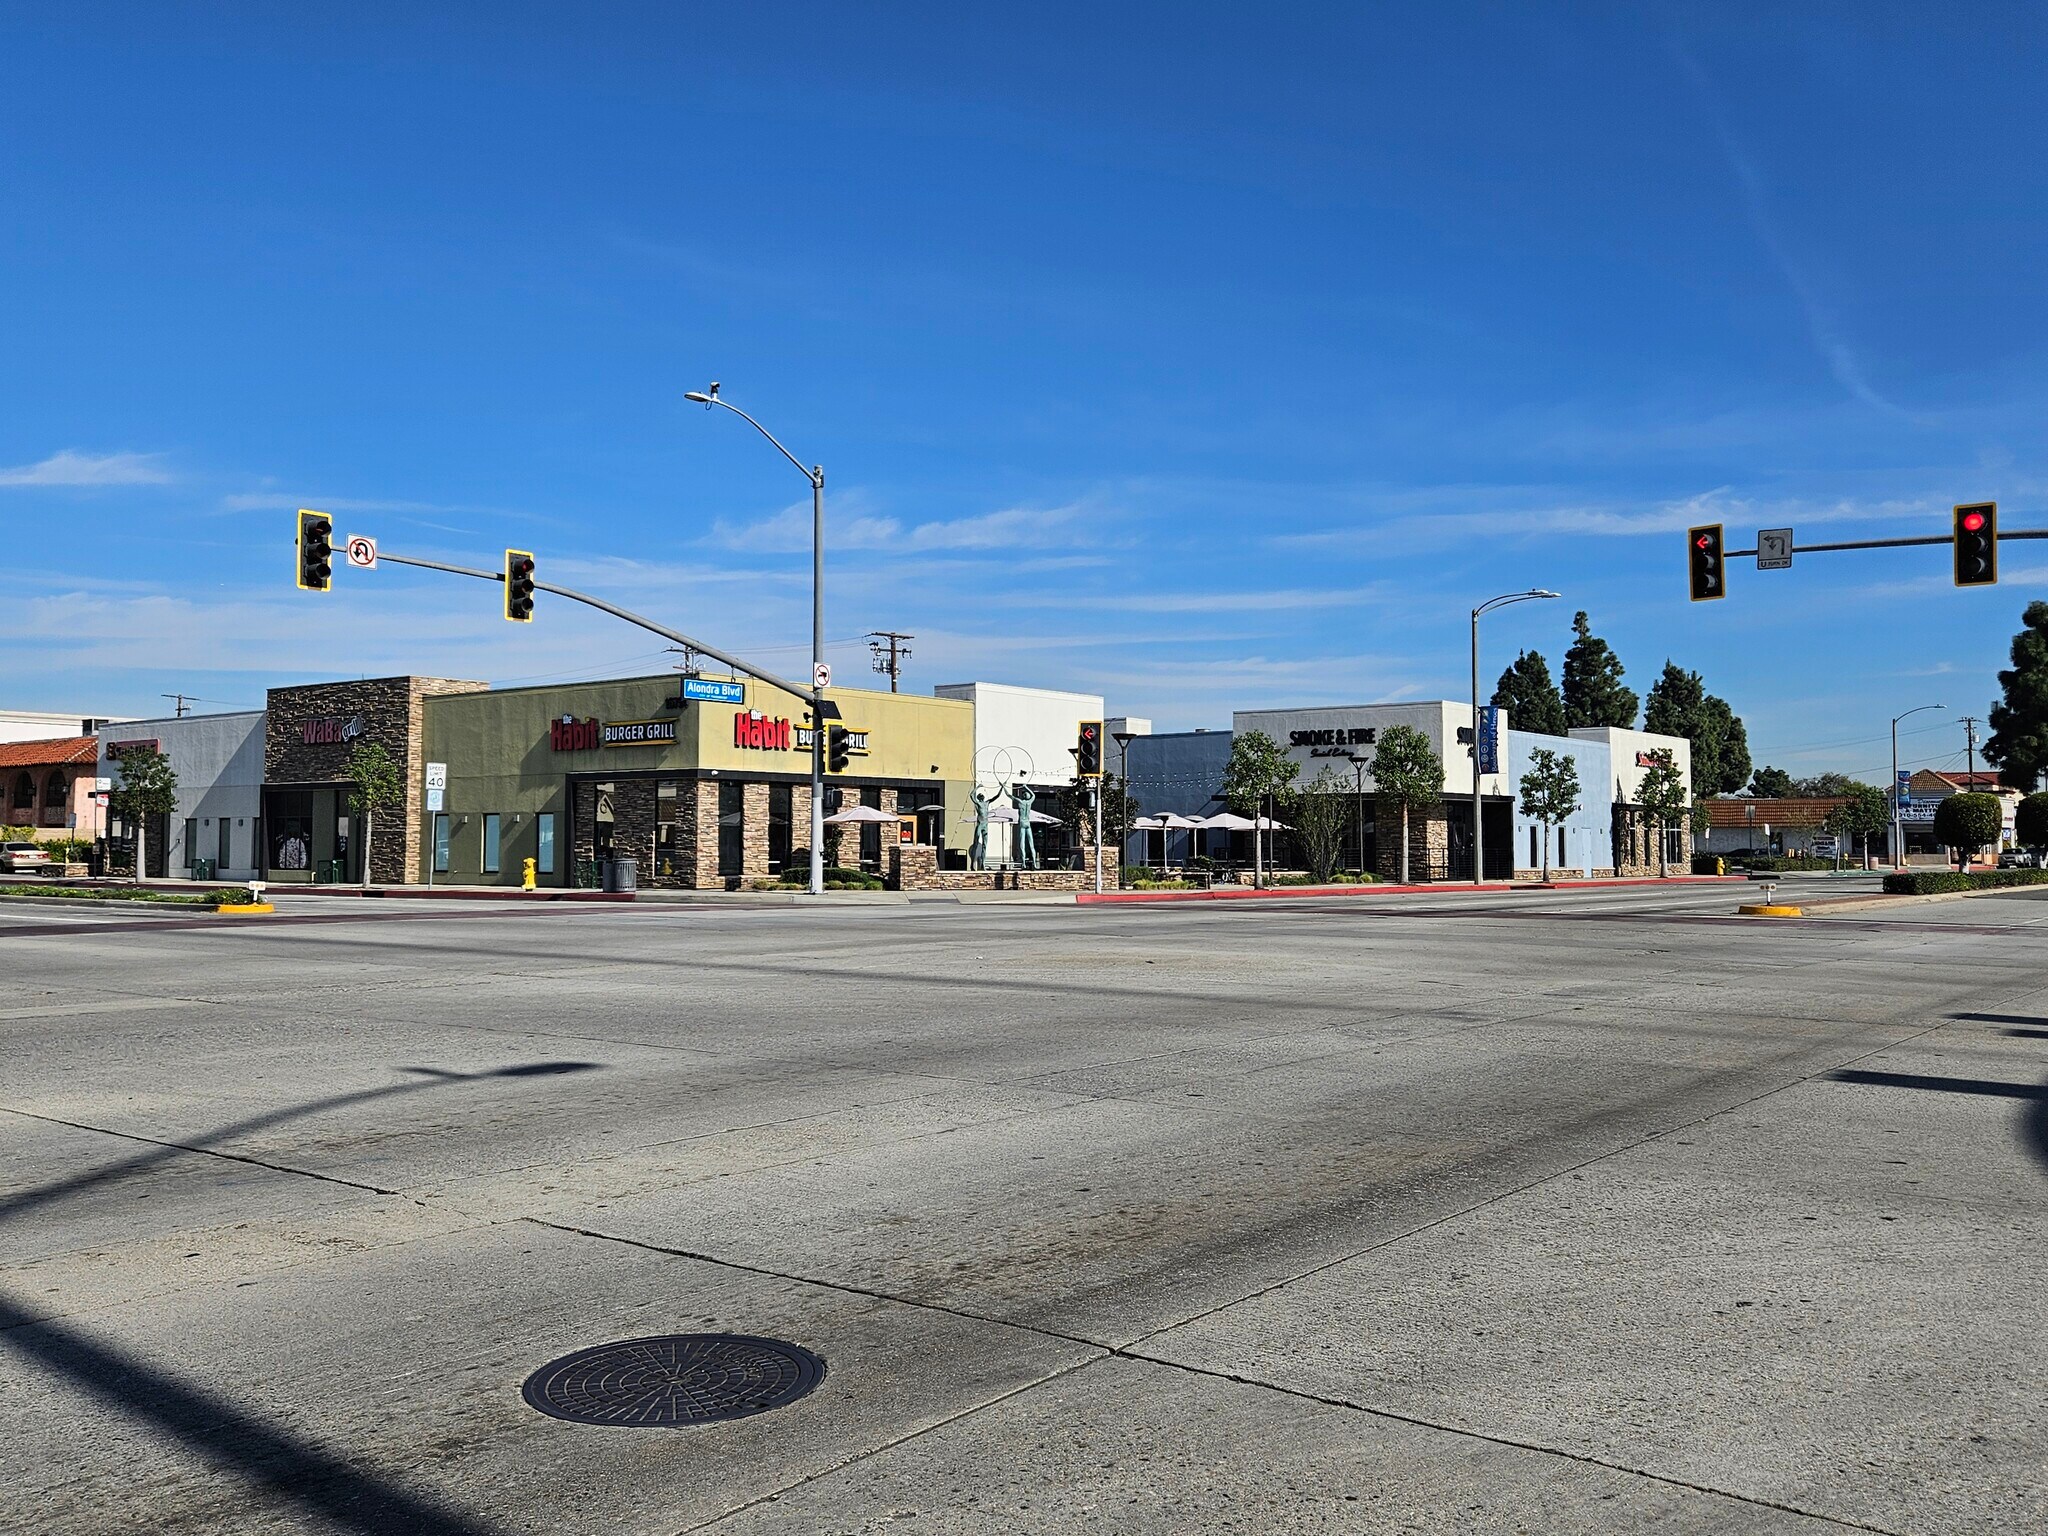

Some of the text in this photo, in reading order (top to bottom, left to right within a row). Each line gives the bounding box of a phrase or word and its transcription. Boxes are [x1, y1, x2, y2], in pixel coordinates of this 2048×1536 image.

[687, 682, 719, 694] Alondra
[722, 685, 740, 696] Blvd
[751, 709, 762, 720] the
[303, 720, 342, 743] WaBa
[551, 716, 599, 751] Habit
[605, 723, 675, 741] BURGER GRILL
[735, 712, 791, 750] Habit
[1289, 728, 1376, 746] SMOKE & FIRE
[428, 777, 444, 787] 40
